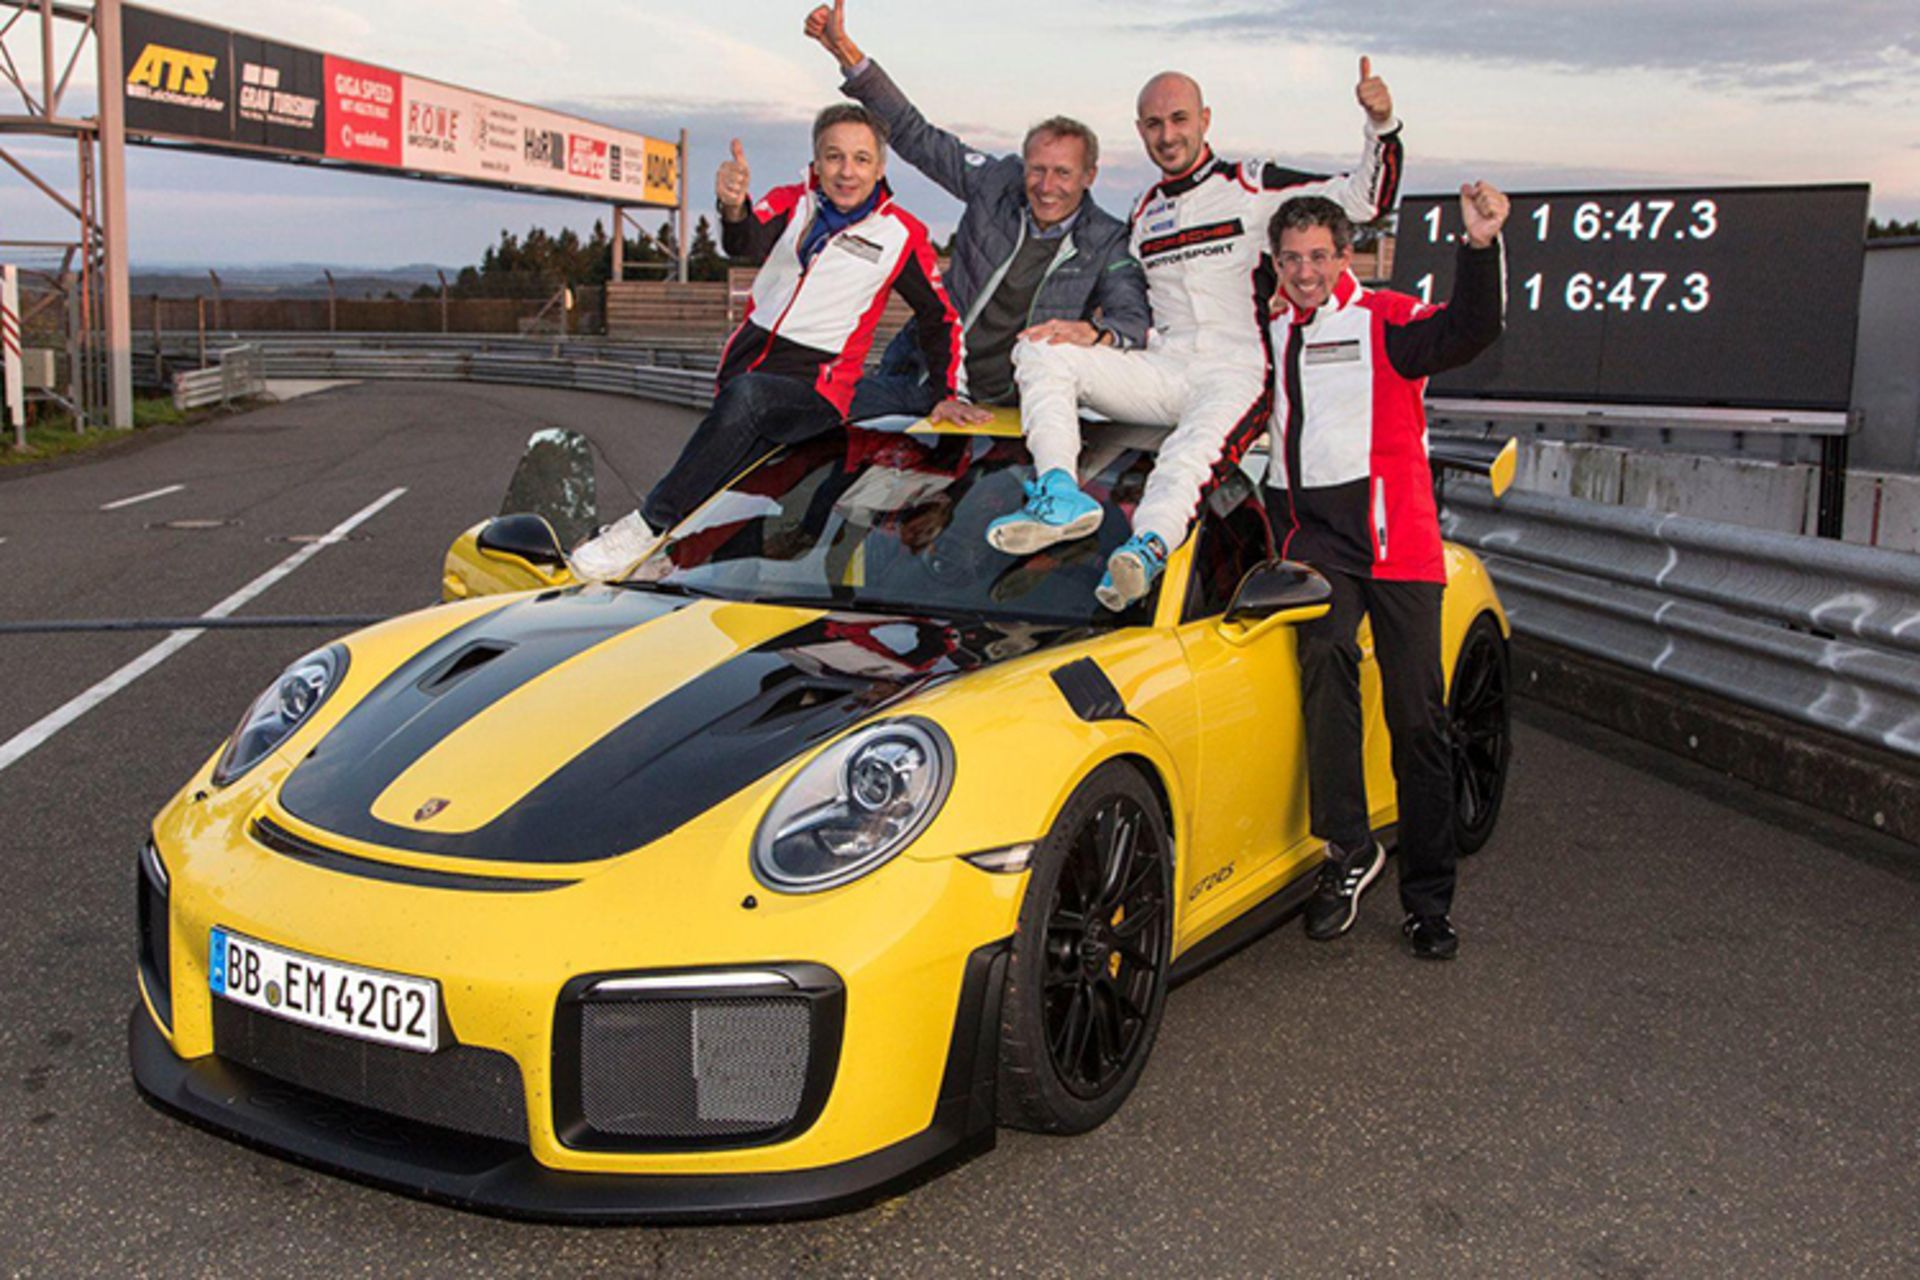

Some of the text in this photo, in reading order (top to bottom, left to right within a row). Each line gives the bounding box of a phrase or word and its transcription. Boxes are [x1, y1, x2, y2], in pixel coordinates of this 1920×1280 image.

[127, 43, 218, 96] ATS
[335, 74, 394, 105] GIGA SPEED
[409, 101, 459, 141] ROWE
[409, 136, 439, 149] MOTOR
[1531, 203, 1551, 242] 1
[1572, 199, 1718, 241] 6:47.3
[1146, 243, 1234, 269] MOTORSPORT
[1524, 272, 1543, 311] 1
[1564, 272, 1711, 312] 6:47.3
[227, 943, 427, 1038] BB EM 4202
